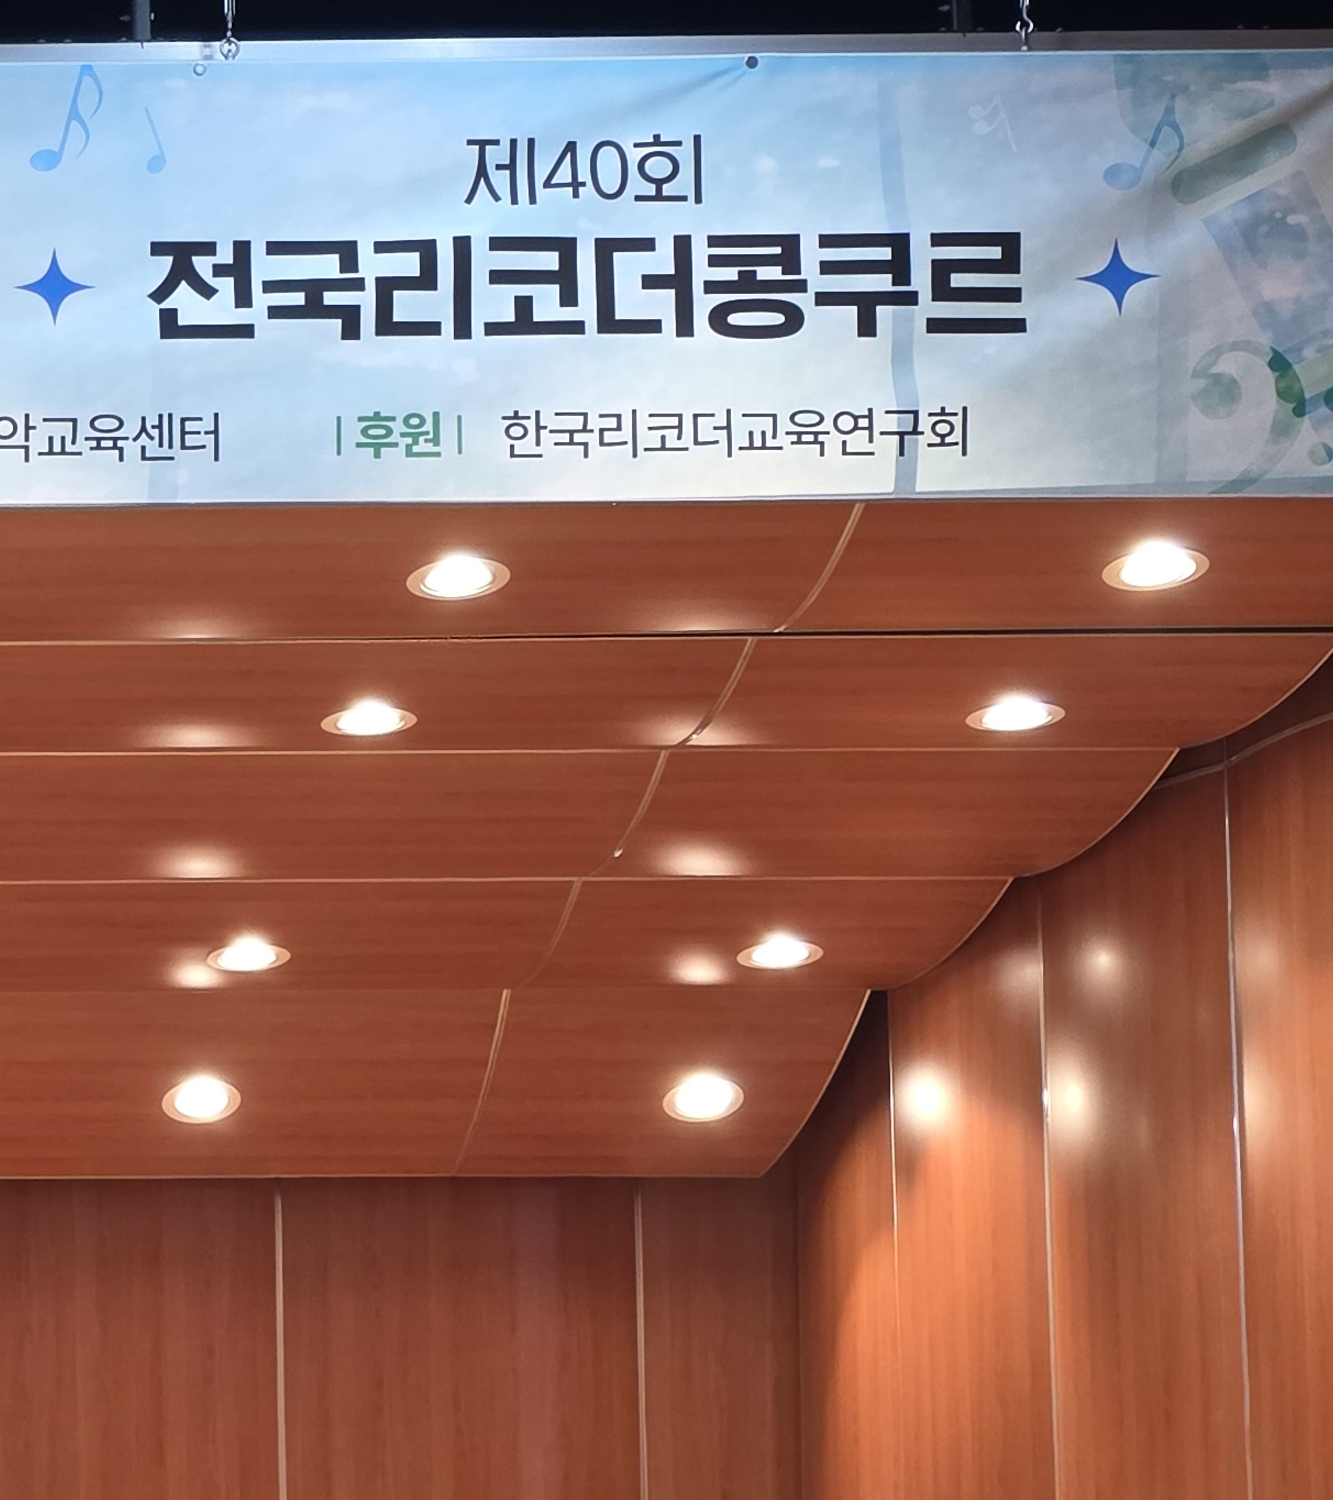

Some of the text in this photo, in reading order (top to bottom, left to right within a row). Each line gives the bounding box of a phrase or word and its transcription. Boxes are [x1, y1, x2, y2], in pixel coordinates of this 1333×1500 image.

[463, 133, 703, 206] 제40회
[146, 231, 1028, 341] 전국리코더콩쿠르
[355, 405, 968, 460] 후원 한국리코더교육연구회
